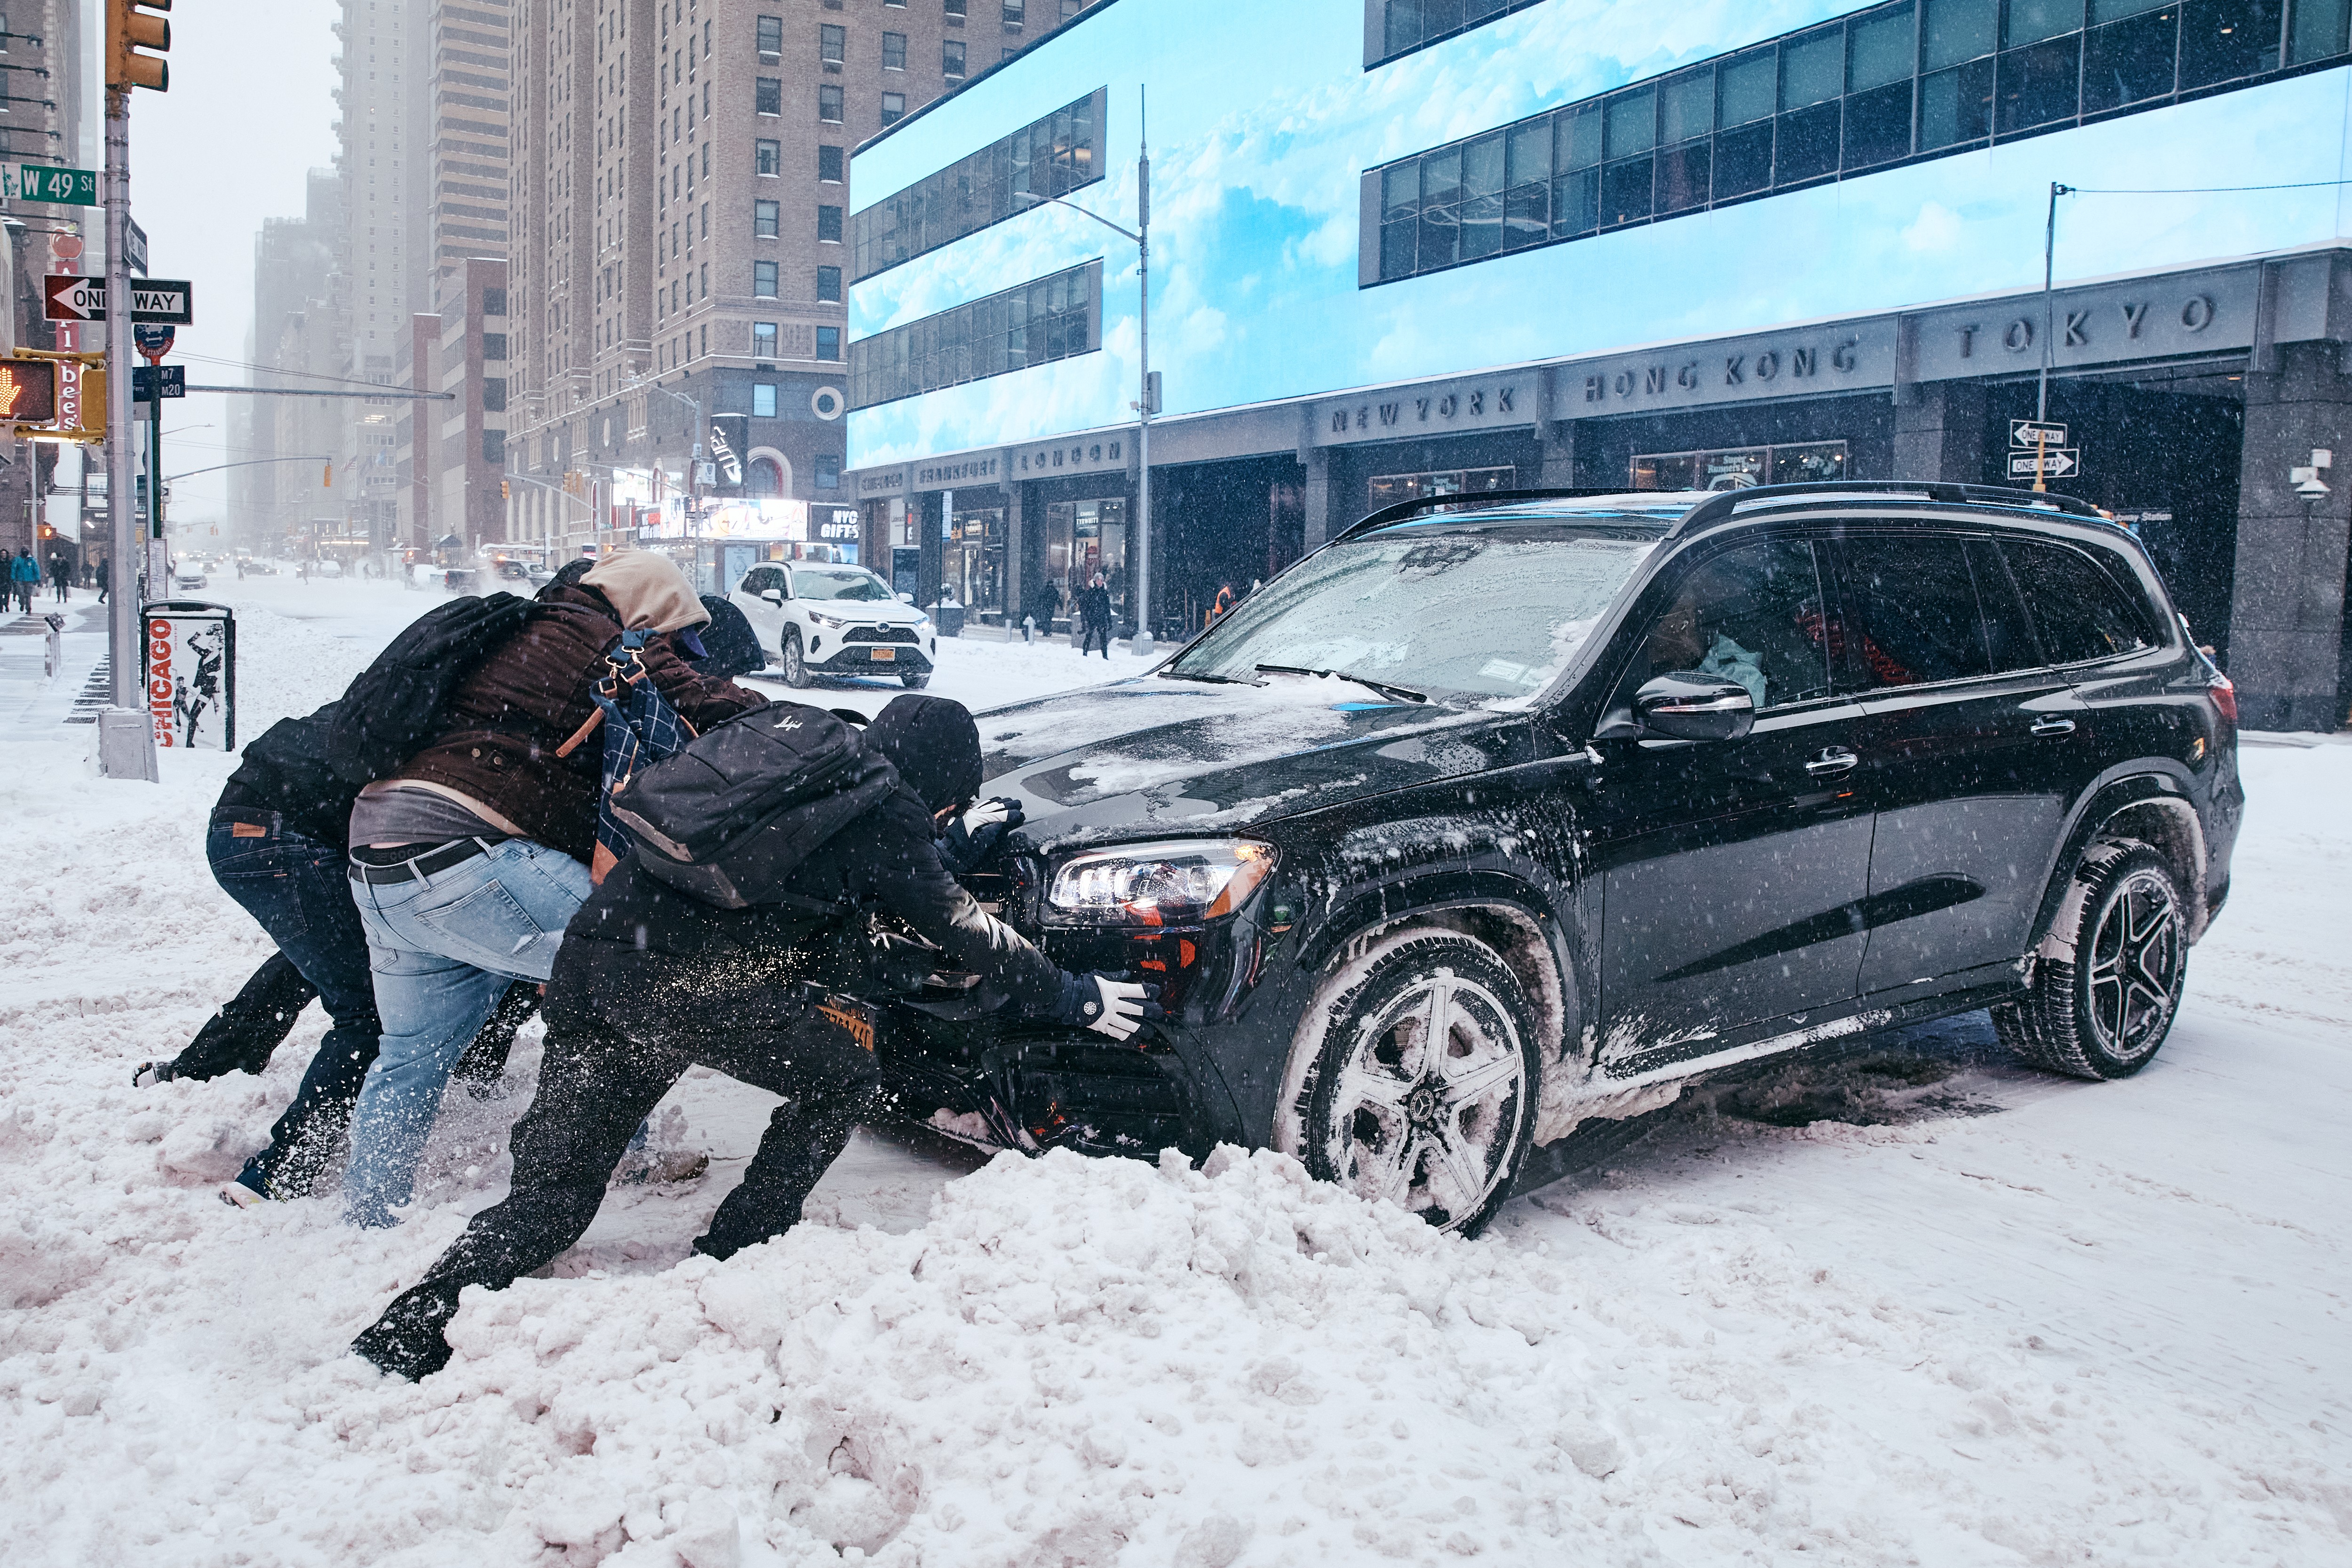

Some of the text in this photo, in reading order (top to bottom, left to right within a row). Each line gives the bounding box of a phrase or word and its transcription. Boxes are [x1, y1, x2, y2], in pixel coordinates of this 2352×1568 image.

[24, 170, 93, 198] W 49 St
[134, 293, 175, 310] WAY
[1954, 294, 2215, 358] TOKYO
[138, 341, 170, 356] NO STANDING
[161, 368, 174, 380] M7
[1586, 340, 1857, 402] HONG KONG
[162, 384, 180, 396] M20
[1332, 388, 1514, 432] NEW YORK
[2022, 430, 2060, 441] ONE WAY
[1021, 442, 1120, 470] LONDON
[2016, 459, 2064, 470] ONE WAY
[833, 510, 858, 524] NYC
[2142, 511, 2172, 521] Station
[821, 523, 859, 539] GIFTS
[150, 620, 173, 747] CHICAGO
